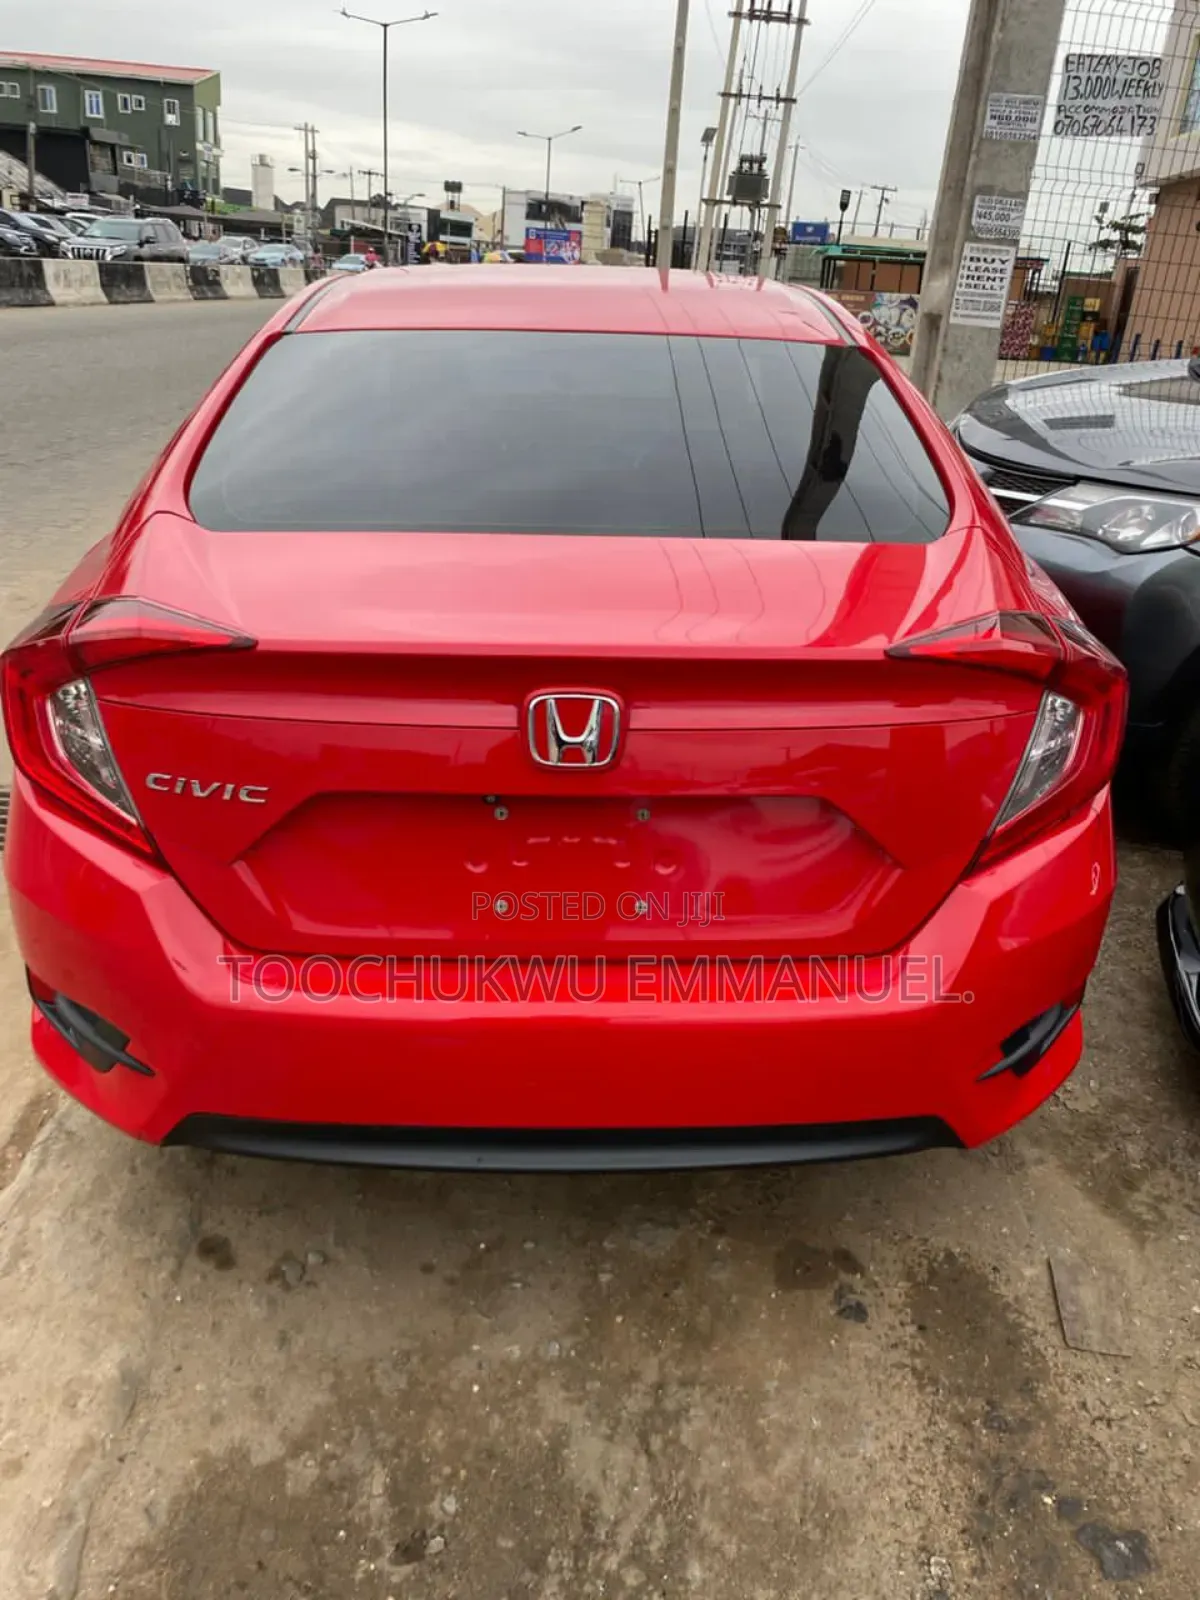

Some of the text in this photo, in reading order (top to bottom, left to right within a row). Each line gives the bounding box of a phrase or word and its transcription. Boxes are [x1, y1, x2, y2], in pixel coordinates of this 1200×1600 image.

[969, 256, 1010, 265] BUY
[967, 266, 1008, 275] LEASE
[966, 274, 1008, 283] RENT
[145, 772, 270, 803] CIVIC
